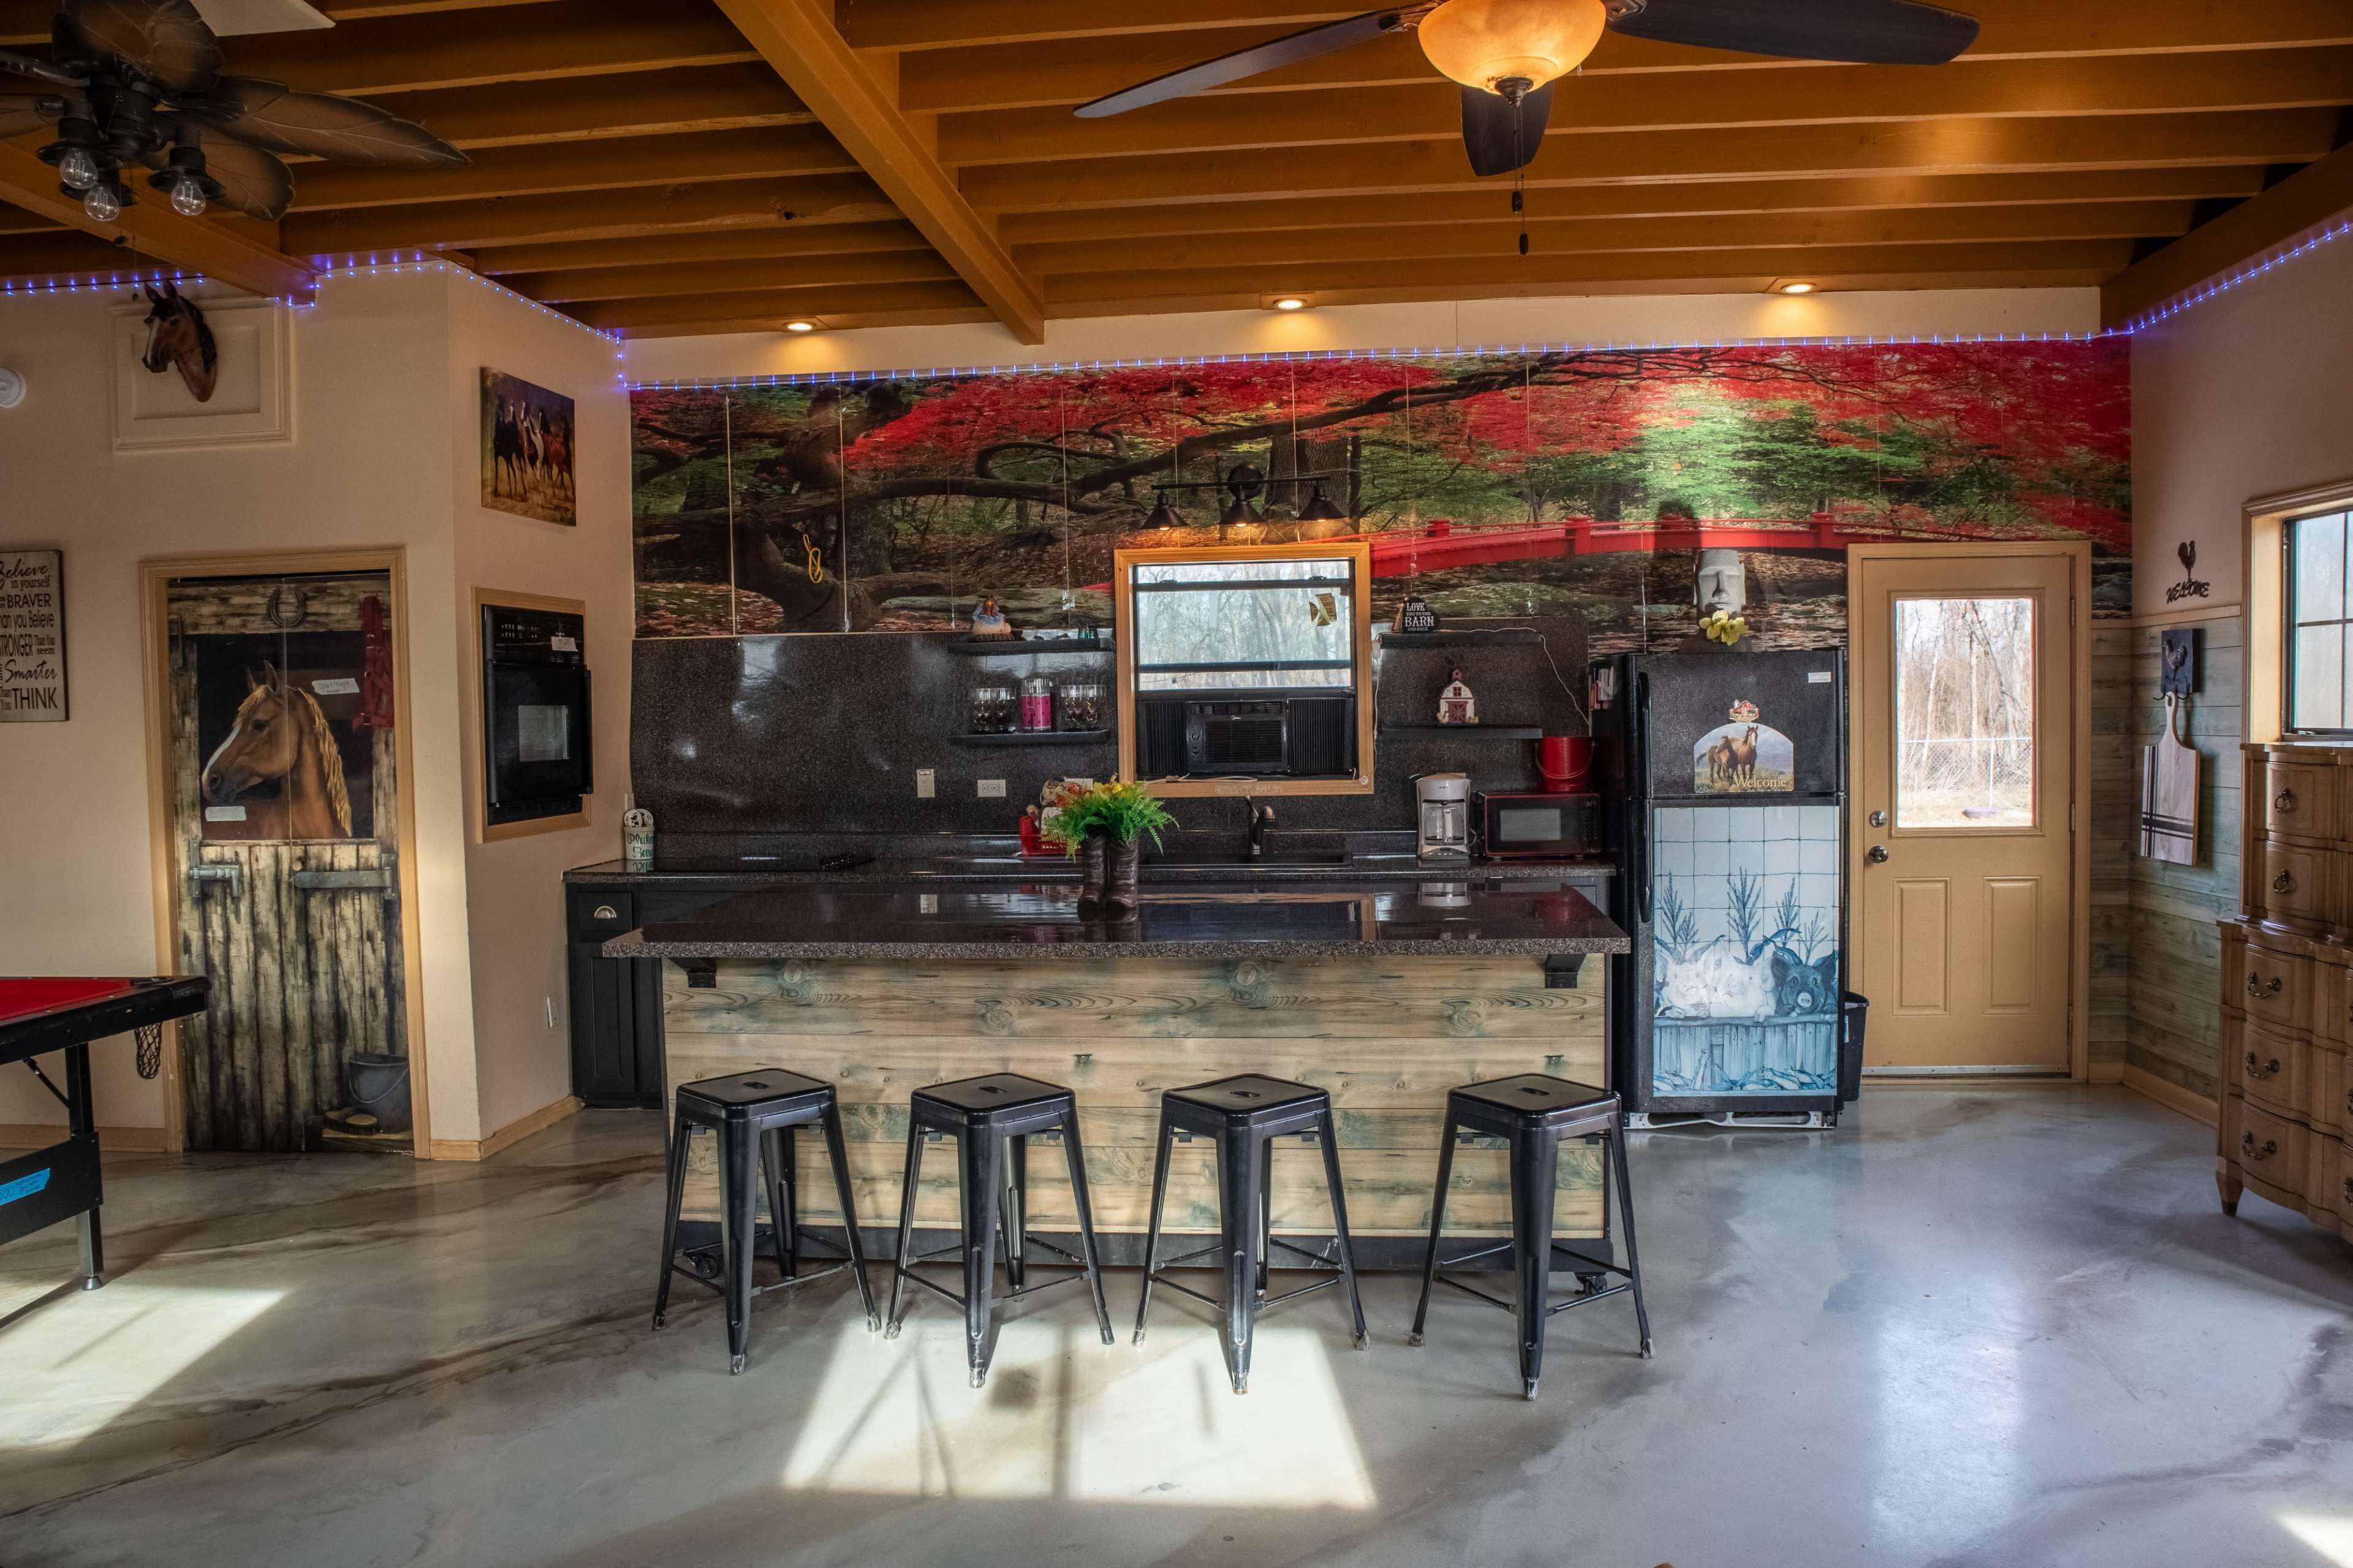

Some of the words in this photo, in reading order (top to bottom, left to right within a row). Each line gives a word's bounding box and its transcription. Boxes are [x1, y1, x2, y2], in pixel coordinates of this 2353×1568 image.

[11, 577, 18, 589] in
[20, 575, 51, 591] yourself
[2165, 580, 2210, 604] WELCOME
[7, 593, 51, 608] BRAVER
[1406, 602, 1425, 612] LOVE
[13, 613, 27, 632] you
[29, 610, 55, 628] Believe
[1404, 616, 1434, 627] BARN
[0, 634, 33, 657] TRONGER
[5, 659, 58, 683] Smarter
[12, 687, 58, 710] THINK
[1733, 775, 1787, 788] Welcome
